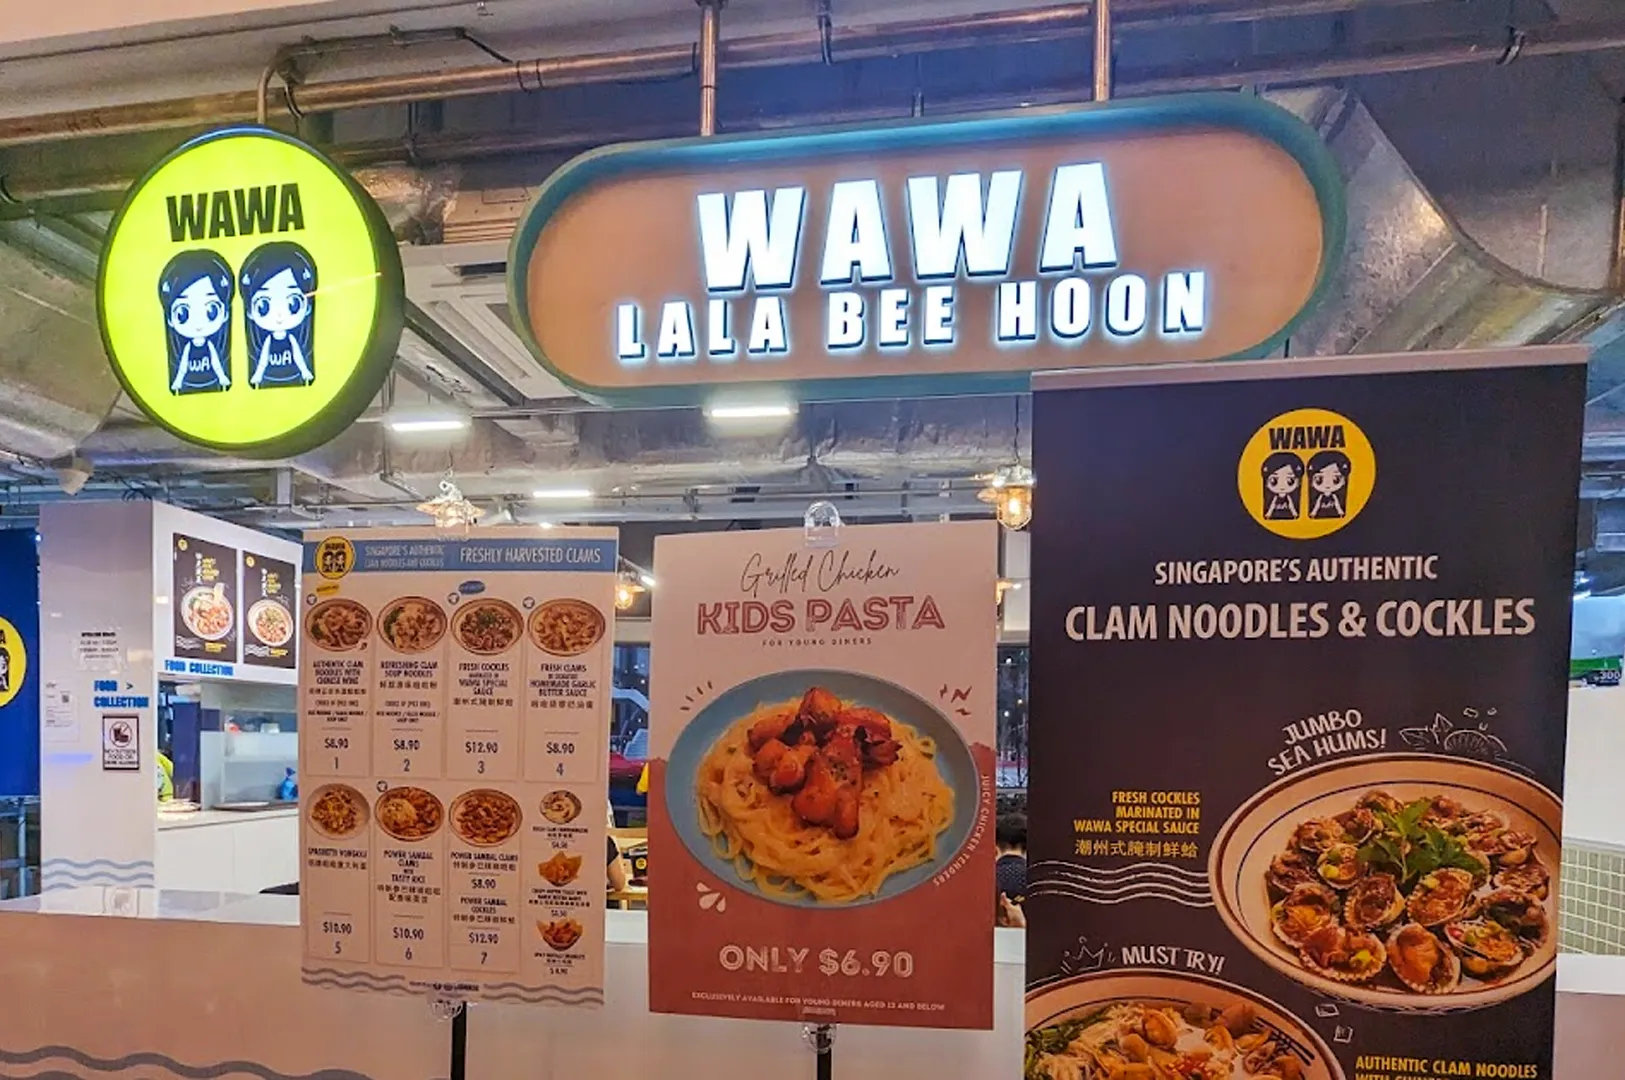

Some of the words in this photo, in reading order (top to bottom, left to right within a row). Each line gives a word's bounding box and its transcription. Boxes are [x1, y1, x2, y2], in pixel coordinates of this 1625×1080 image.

[166, 183, 305, 242] WAWA
[697, 162, 1118, 292] WAWA
[617, 296, 789, 359] LALA
[827, 286, 954, 350] BEE
[997, 272, 1204, 341] HOON
[1269, 425, 1346, 450] WAWA
[460, 547, 502, 563] FRESHLY
[505, 547, 563, 563] HARVESTED
[566, 547, 601, 563] CLAMS
[741, 553, 813, 597] Grilled
[818, 550, 900, 592] Chicken
[1155, 559, 1301, 585] SINGAPORE'S
[1305, 555, 1438, 582] AUTHENTIC
[697, 600, 796, 635] KIDS
[806, 595, 945, 632] PASTA
[1065, 605, 1157, 641] CLAM
[1168, 602, 1329, 640] NOODLES
[1338, 603, 1366, 637] &
[1376, 598, 1535, 637] COCKLES
[832, 637, 872, 645] DINERS
[165, 660, 186, 672] FOOD
[190, 662, 234, 676] COLLECTION
[94, 680, 118, 691] FOOD
[94, 696, 149, 708] COLLECTION
[1282, 709, 1361, 745] JUMBO
[394, 739, 420, 751] $8.90
[465, 742, 499, 754] $12.90
[546, 742, 575, 754] $8.90
[1268, 745, 1311, 775] SEA
[1313, 728, 1387, 757] HUMS!
[335, 757, 339, 769] 1
[404, 758, 411, 772] 2
[477, 760, 485, 774] 3
[556, 763, 564, 776] 4
[981, 774, 991, 805] JUICY
[1112, 791, 1147, 803] FRESH
[1151, 791, 1200, 804] COCKLES
[1115, 806, 1183, 819] MARINATED
[1187, 807, 1200, 820] IN
[967, 807, 990, 851] CHICKEN
[1073, 819, 1112, 833] WAWA
[1115, 820, 1159, 834] SPECIAL
[1163, 821, 1199, 835] SAUCE
[933, 853, 970, 886] TENDERS
[323, 921, 352, 935] $10.90
[393, 926, 424, 940] $10.90
[469, 932, 499, 944] $12.90
[335, 940, 341, 955] 5
[405, 947, 412, 960] 6
[480, 951, 487, 964] 7
[719, 945, 809, 973] ONLY
[818, 948, 914, 977] $6.90
[1121, 945, 1181, 966] MUST
[1183, 948, 1225, 976] TRY!
[692, 992, 740, 1002] EXCLUSIVELY
[742, 995, 783, 1004] AVAILABLE
[803, 998, 830, 1006] YOUNG
[832, 999, 862, 1008] DINERS
[864, 1000, 885, 1009] AGED
[898, 1002, 915, 1010] AND
[917, 1003, 945, 1011] BELOW
[1355, 1056, 1429, 1072] AUTHENTIC
[1432, 1060, 1471, 1076] CLAM
[1475, 1063, 1538, 1079] NOODLES
